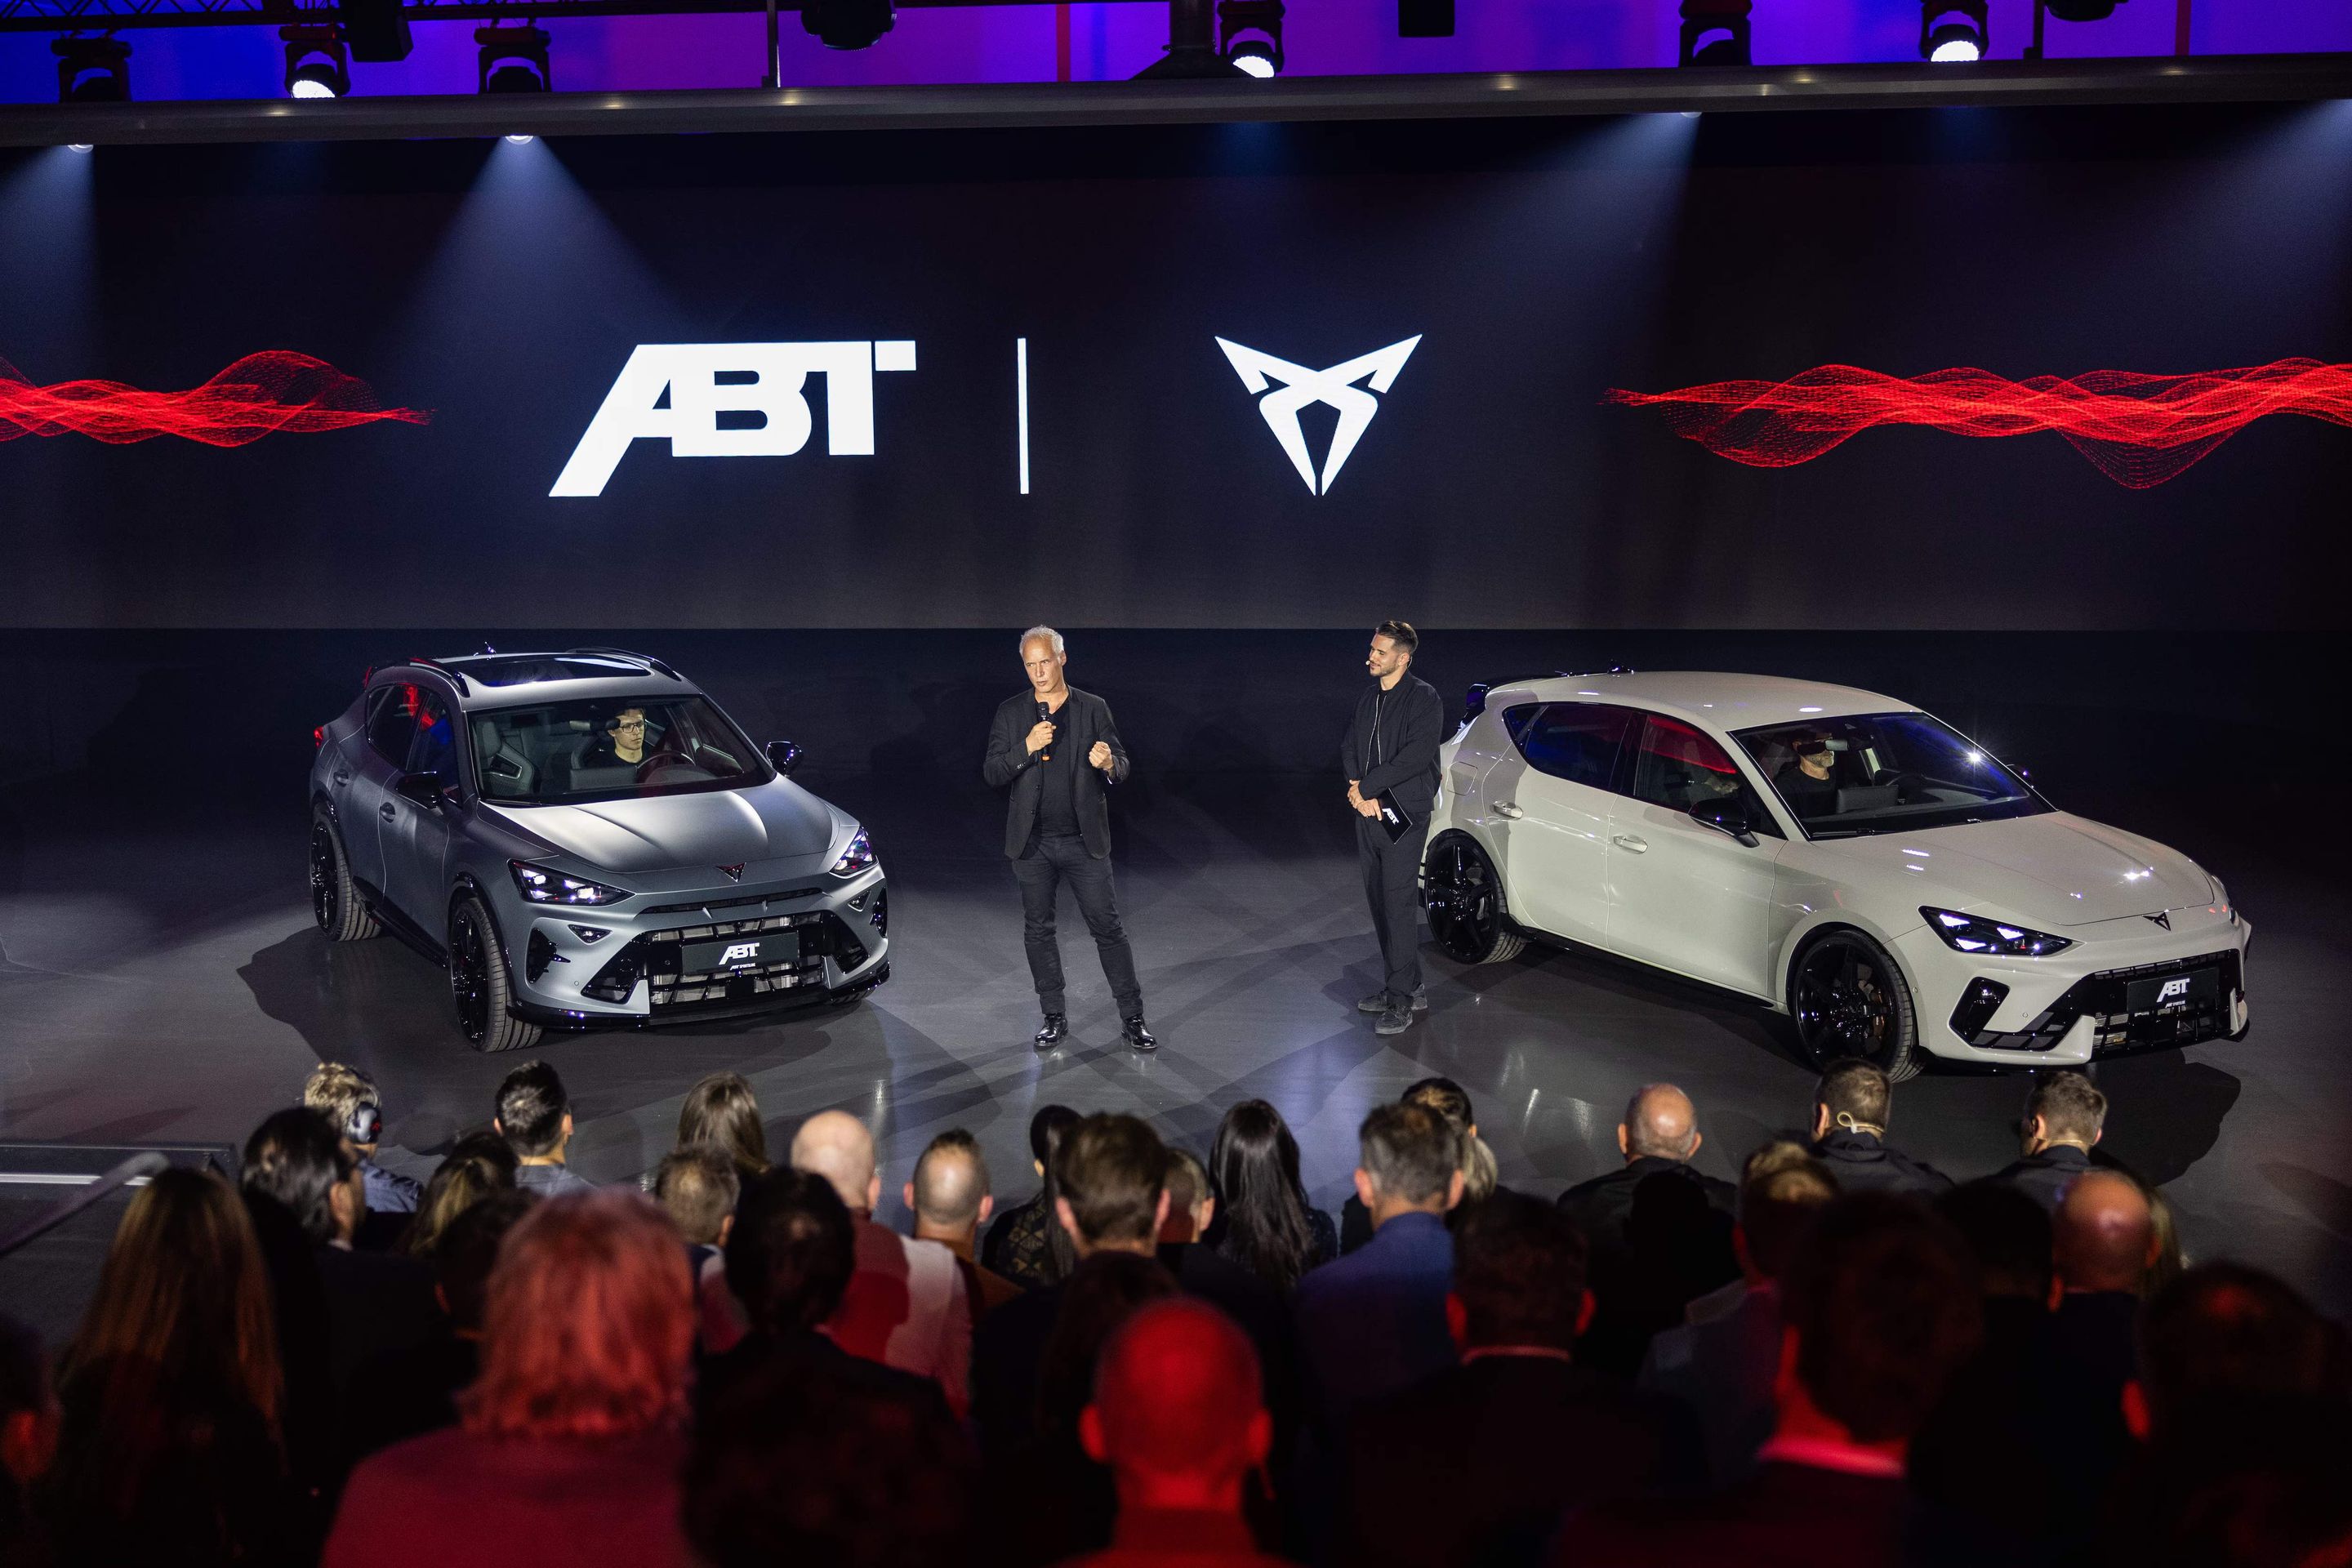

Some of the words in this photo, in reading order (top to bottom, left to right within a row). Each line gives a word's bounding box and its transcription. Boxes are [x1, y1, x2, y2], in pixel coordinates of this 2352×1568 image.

[548, 340, 916, 497] ABT
[719, 942, 760, 964] ABT
[2156, 978, 2189, 1002] ABT
